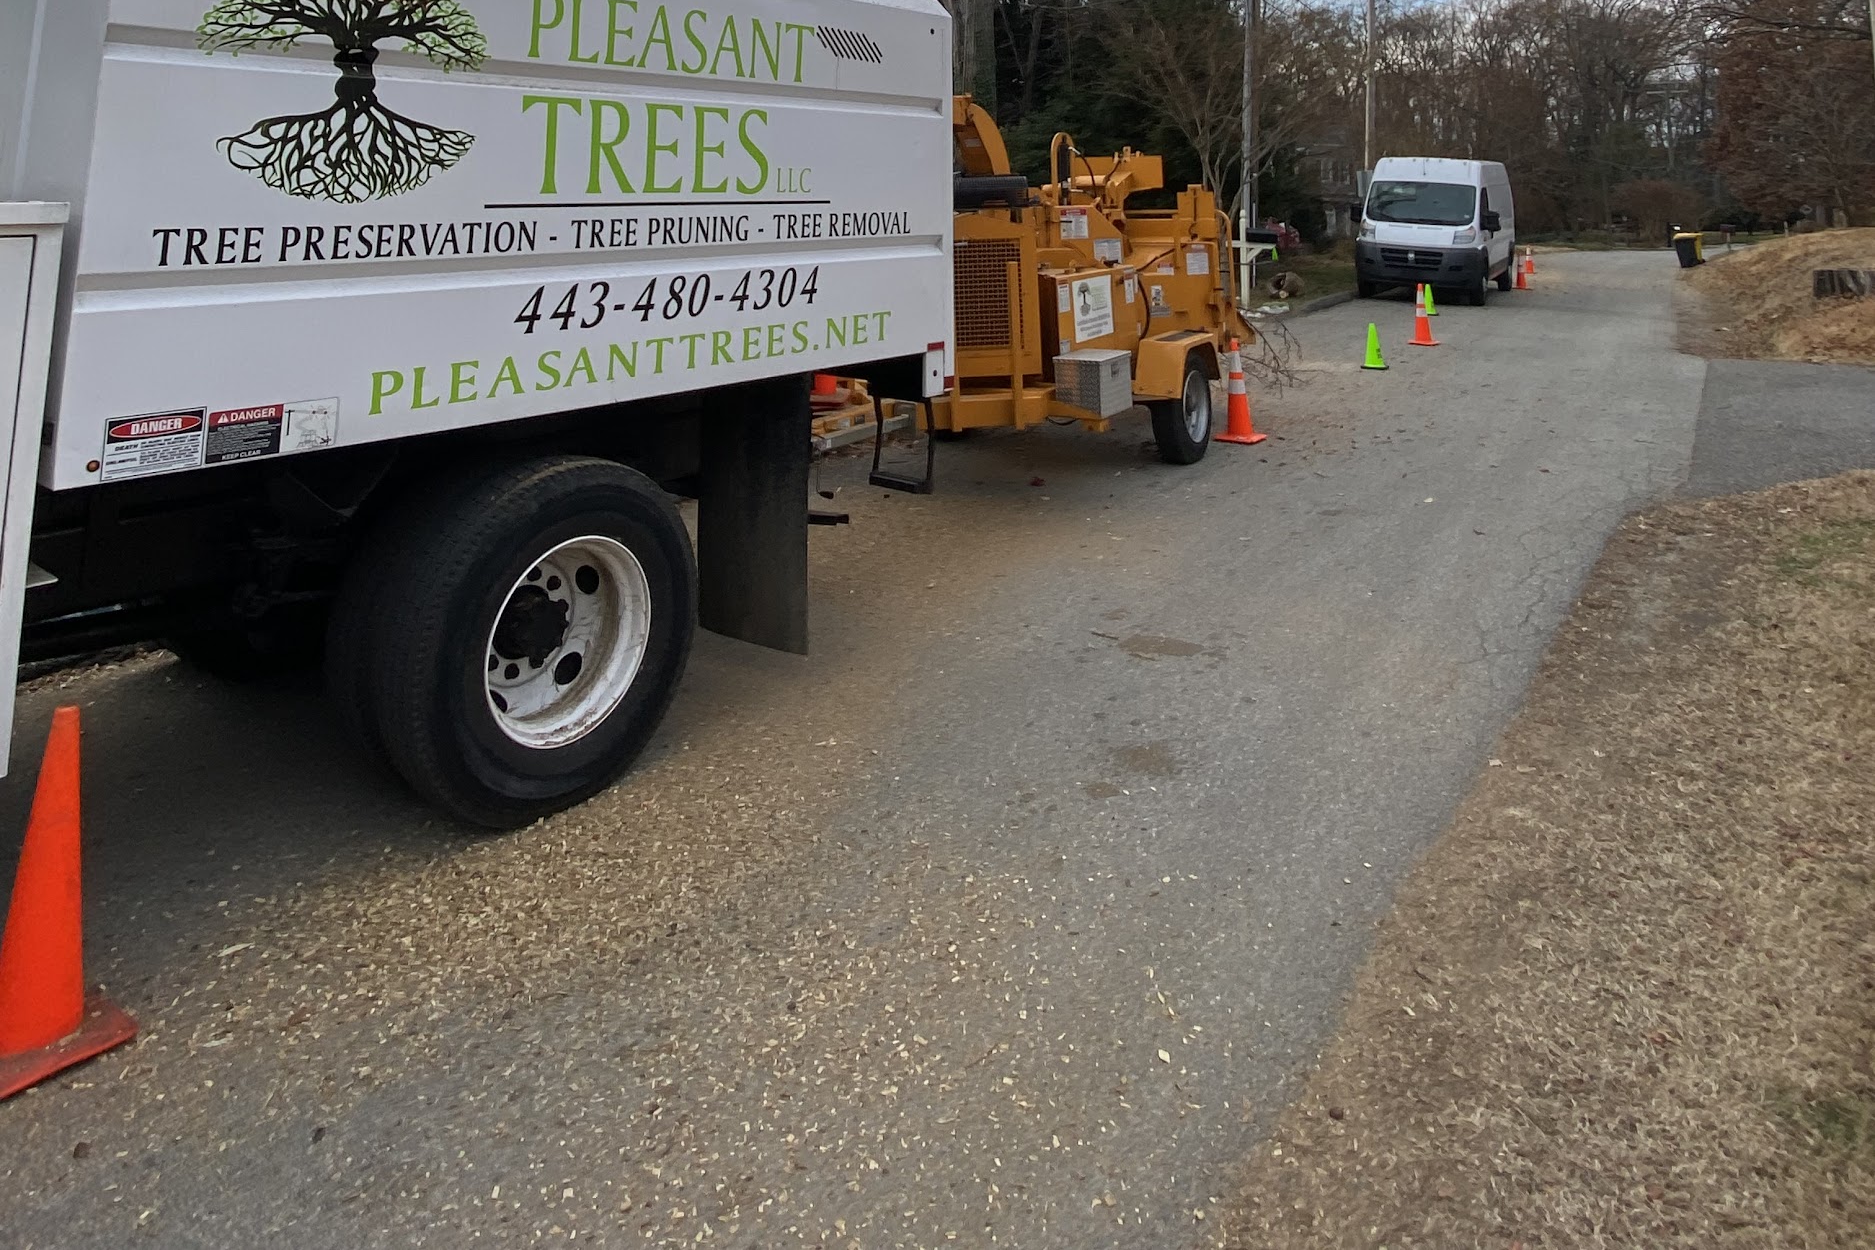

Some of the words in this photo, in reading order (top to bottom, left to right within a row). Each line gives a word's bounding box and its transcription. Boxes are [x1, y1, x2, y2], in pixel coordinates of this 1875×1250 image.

[522, 95, 769, 195] TREES
[776, 168, 812, 193] LLC
[153, 227, 265, 267] TREE
[279, 221, 538, 262] PRESERVATION
[571, 218, 638, 250] TREE
[647, 215, 750, 245] PRUNING
[773, 214, 822, 239] TREE
[828, 212, 911, 237] REMOVAL
[514, 265, 819, 335] 443-480-4304
[368, 311, 892, 416] PLEASANTTREES.NET
[130, 417, 183, 435] DANGER
[230, 407, 276, 422] DANGER
[221, 452, 239, 461] KEEP
[240, 449, 261, 458] CLEAR
